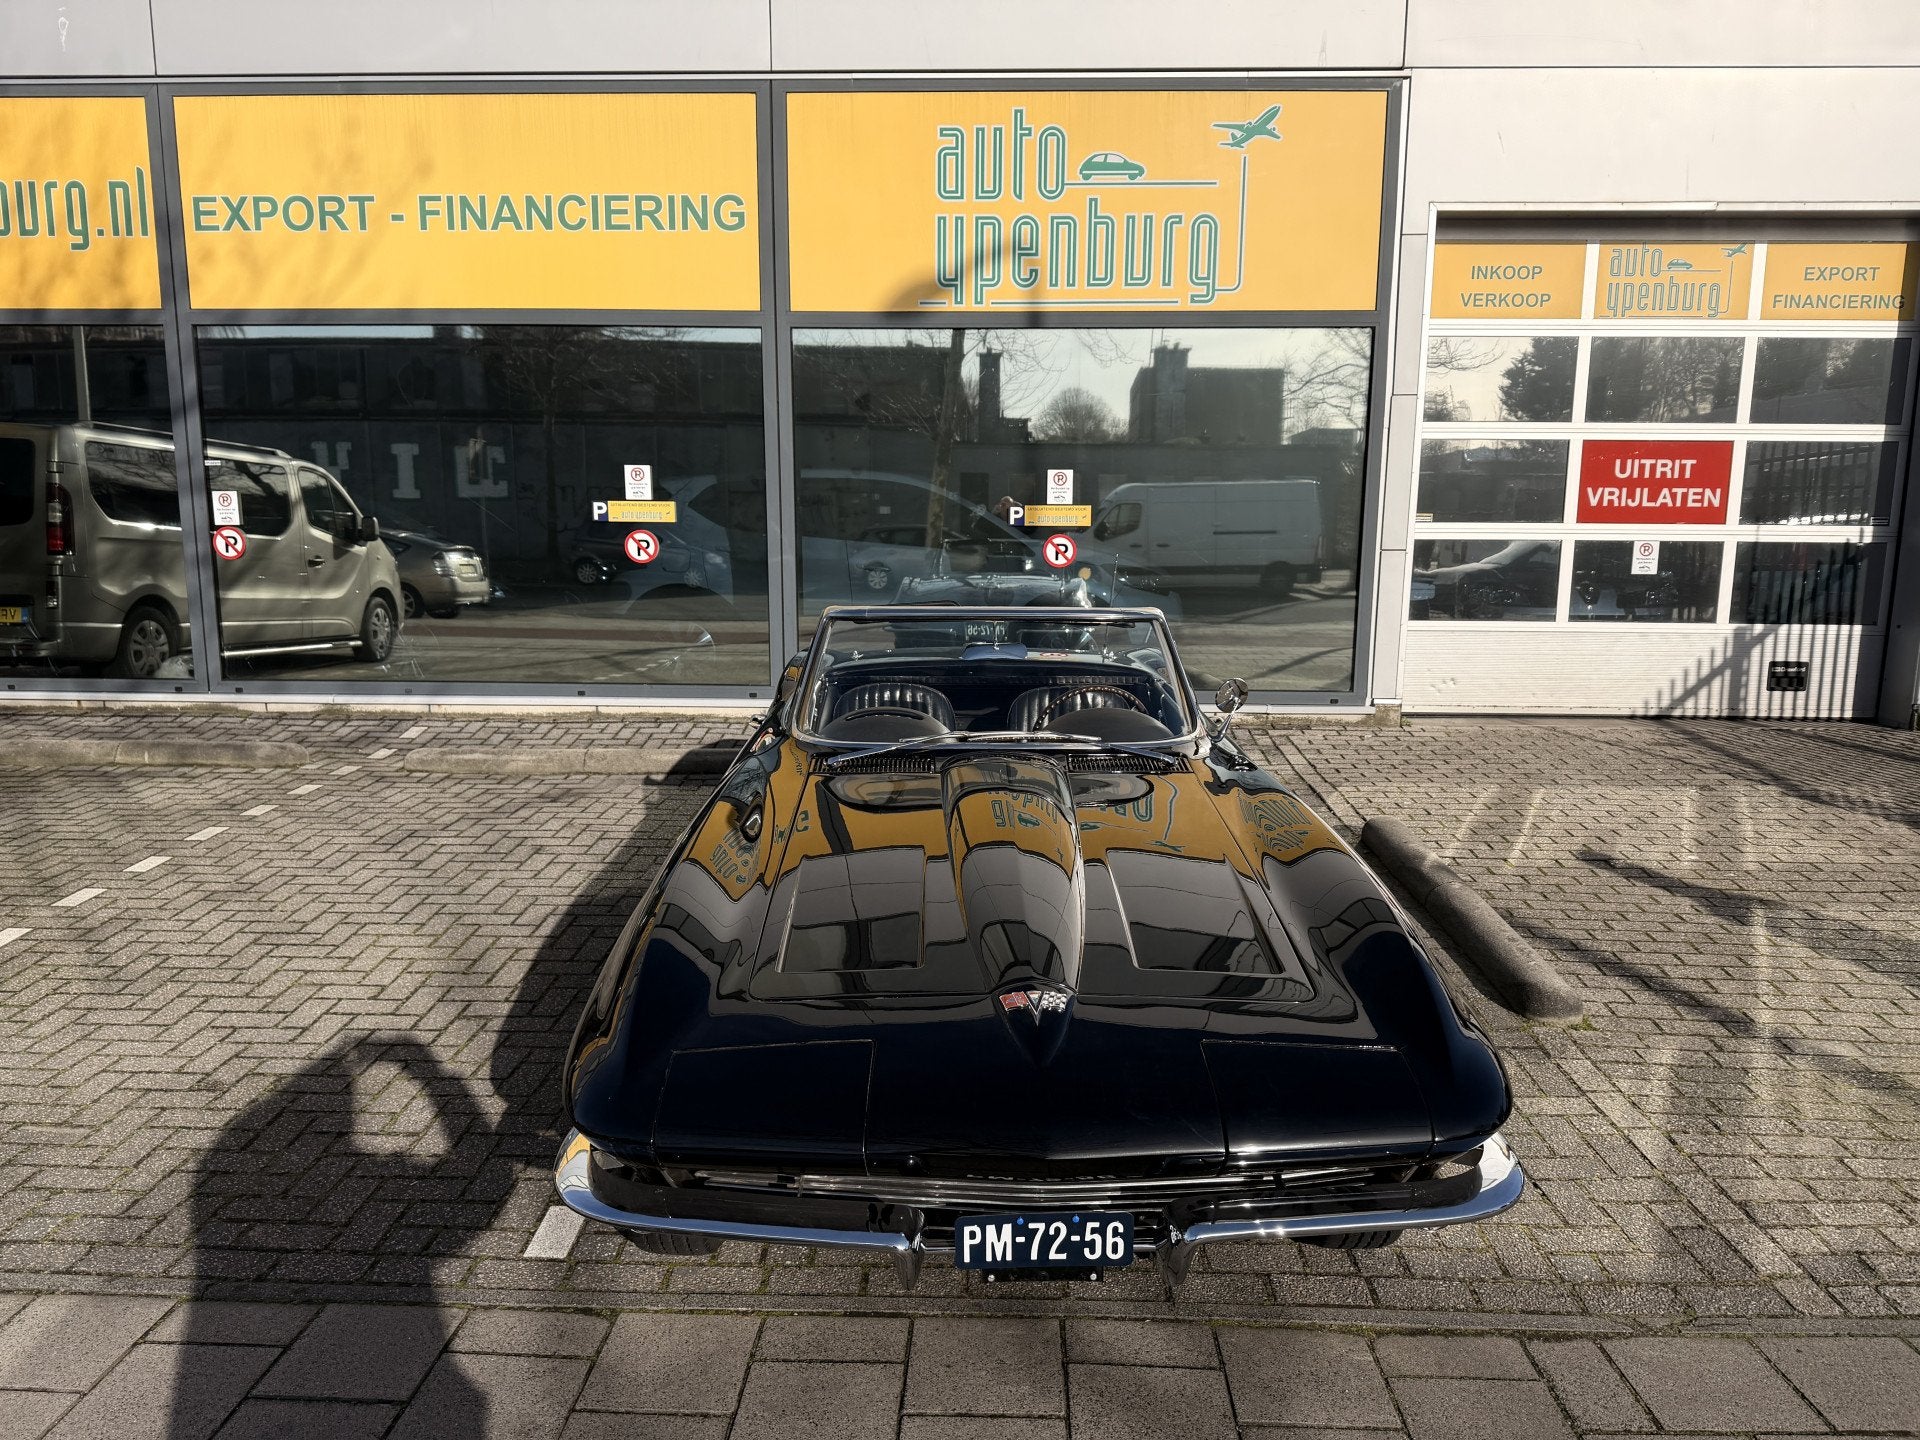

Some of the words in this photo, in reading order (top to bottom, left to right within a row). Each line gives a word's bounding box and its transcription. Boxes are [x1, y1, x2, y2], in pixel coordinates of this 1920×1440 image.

[937, 107, 1067, 201] auto
[194, 194, 374, 231] EXPORT
[419, 194, 746, 231] FINANCIERING
[936, 196, 1220, 305] ypenburg
[1609, 242, 1664, 277] auto
[1471, 264, 1543, 281] INKOOP
[1803, 266, 1880, 282] EXPORT
[1460, 292, 1552, 308] VERKOOP
[1606, 276, 1721, 318] ypenburg
[1772, 293, 1905, 309] FINANCIERING
[1614, 458, 1697, 479] UITRIT
[1586, 486, 1722, 508] VRIJLATEN
[593, 501, 607, 520] P
[1009, 506, 1024, 525] P
[963, 1220, 1125, 1263] PM-72-56
